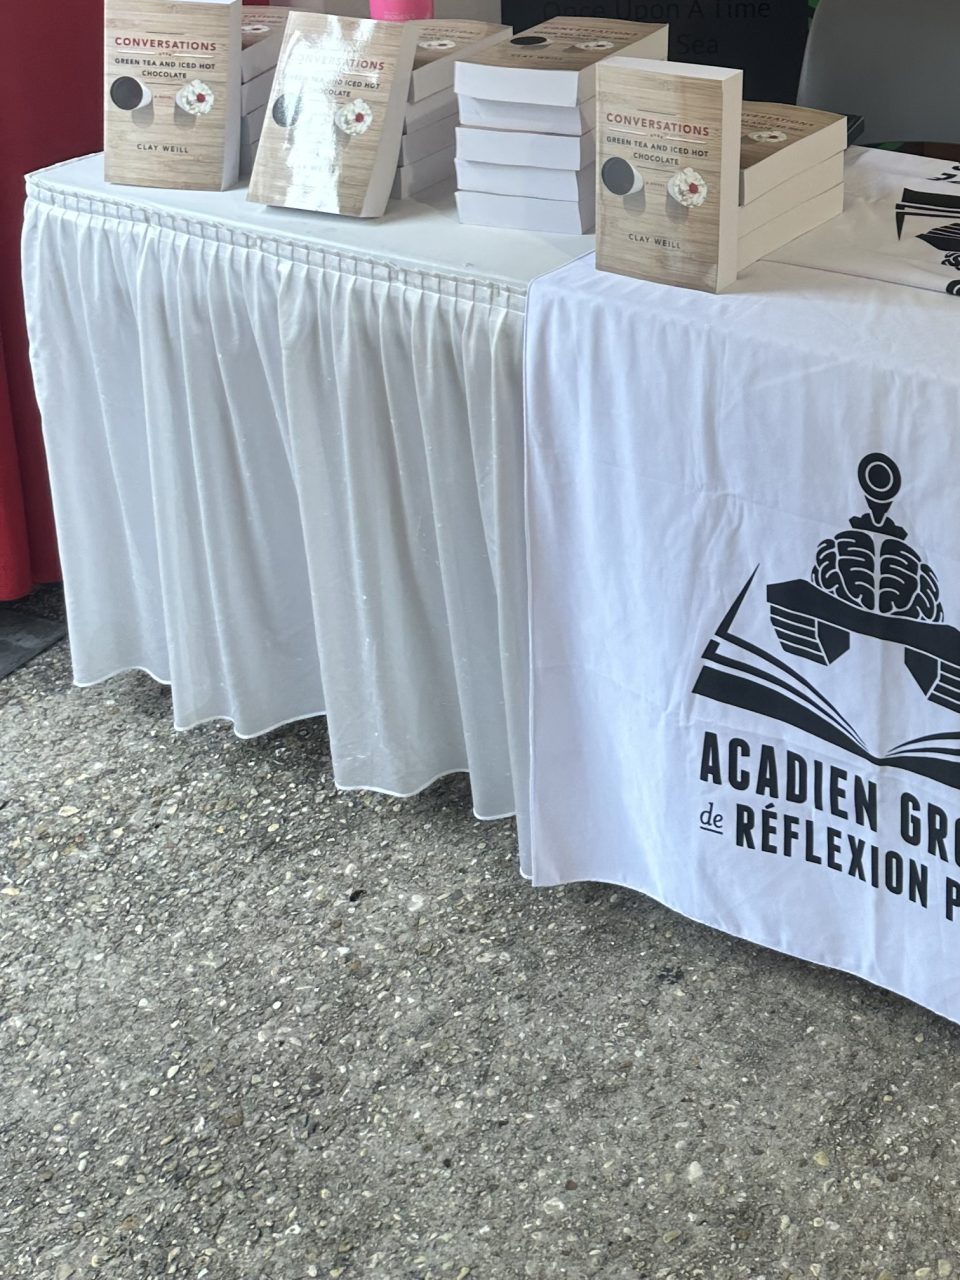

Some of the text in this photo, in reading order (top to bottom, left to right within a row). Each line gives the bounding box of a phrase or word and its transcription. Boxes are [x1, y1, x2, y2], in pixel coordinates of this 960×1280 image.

[615, 0, 680, 23] Upon
[115, 37, 217, 51] CONVERSATIONS
[677, 33, 719, 55] Sea
[114, 57, 140, 65] GREEN
[142, 70, 187, 79] CHOCOLATE
[607, 113, 710, 137] CONVERSATIONS
[136, 143, 189, 153] CLAY WEILL
[606, 136, 709, 157] GREEN TEA AND ICED HOT
[633, 152, 680, 166] CHOCOLATE
[628, 233, 681, 250] CLAY WEILL
[700, 731, 878, 832] ACADIEN
[700, 802, 723, 834] de
[736, 803, 928, 909] RÉFLEXION
